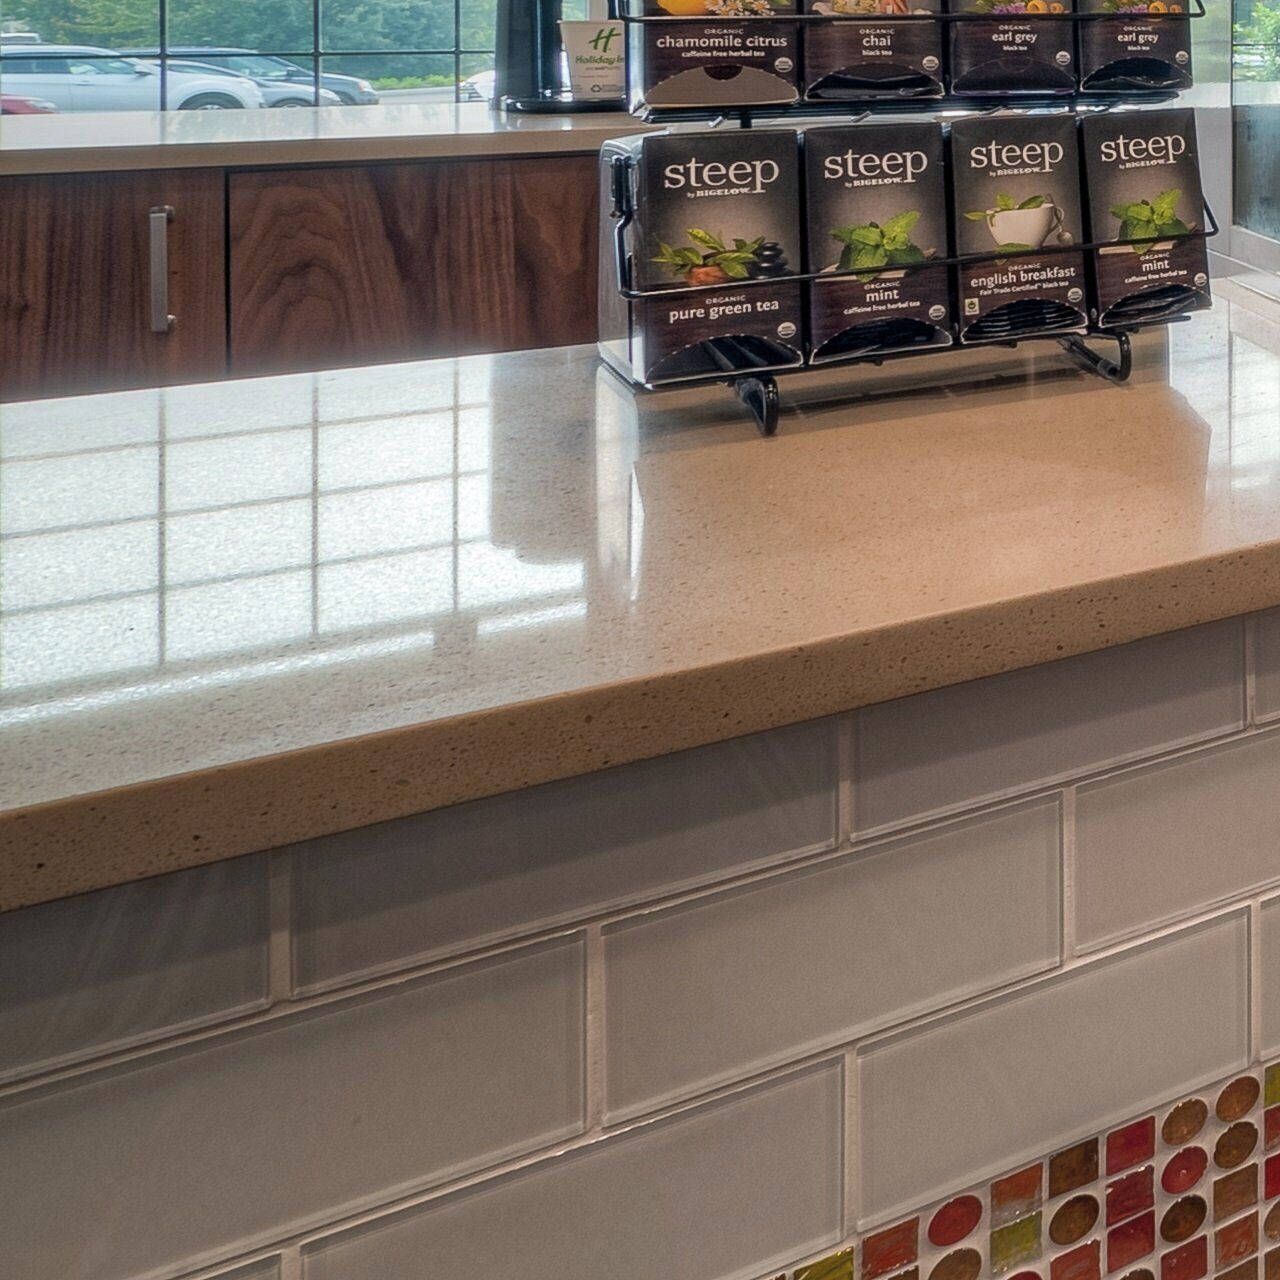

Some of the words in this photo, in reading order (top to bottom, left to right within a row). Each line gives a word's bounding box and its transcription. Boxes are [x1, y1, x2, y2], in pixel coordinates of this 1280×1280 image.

[656, 35, 742, 48] chamomile
[746, 35, 788, 48] citrus
[862, 35, 891, 47] chai
[992, 32, 1013, 42] earl
[1015, 33, 1038, 45] grey
[1117, 33, 1136, 42] earl
[1138, 34, 1159, 45] grey
[576, 55, 615, 65] Holiday
[1101, 134, 1186, 164] steep
[971, 140, 1064, 173] steep
[824, 149, 928, 183] steep
[997, 167, 1041, 176] BIGELOW
[664, 157, 779, 194] steep
[853, 177, 902, 187] BIGELOW
[696, 187, 751, 198] BIGELOW
[1142, 260, 1170, 271] mint
[971, 270, 1017, 288] english
[1020, 266, 1076, 283] breakfast
[705, 295, 747, 304] ORGANIC
[865, 289, 900, 303] mint
[669, 308, 705, 323] pure
[709, 303, 752, 319] green
[756, 298, 779, 312] tea
